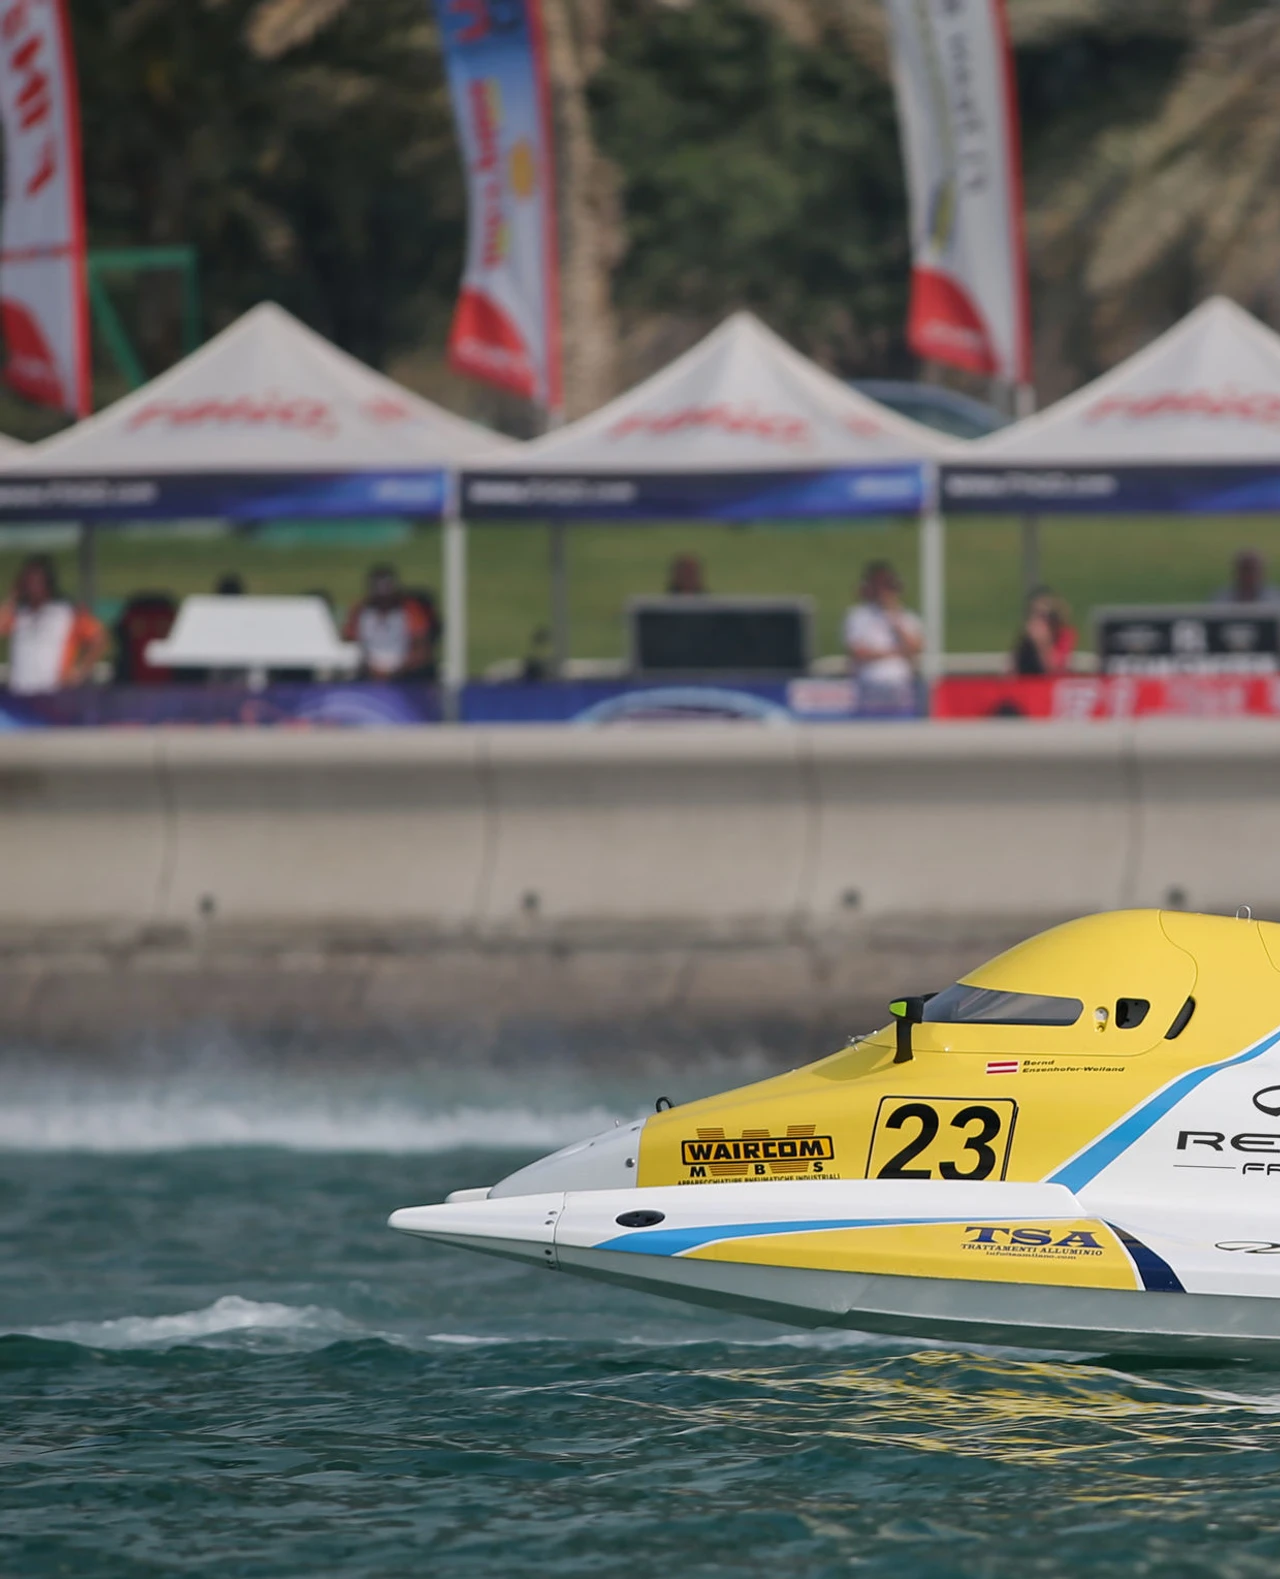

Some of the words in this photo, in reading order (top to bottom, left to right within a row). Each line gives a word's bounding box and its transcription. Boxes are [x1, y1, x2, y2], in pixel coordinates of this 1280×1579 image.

[688, 1140, 824, 1161] WAIRCOM
[876, 1103, 1001, 1180] 23
[965, 1226, 1105, 1249] TSA
[961, 1243, 1037, 1253] TRATTAMENTI
[1039, 1247, 1103, 1257] ALLUMINIO
